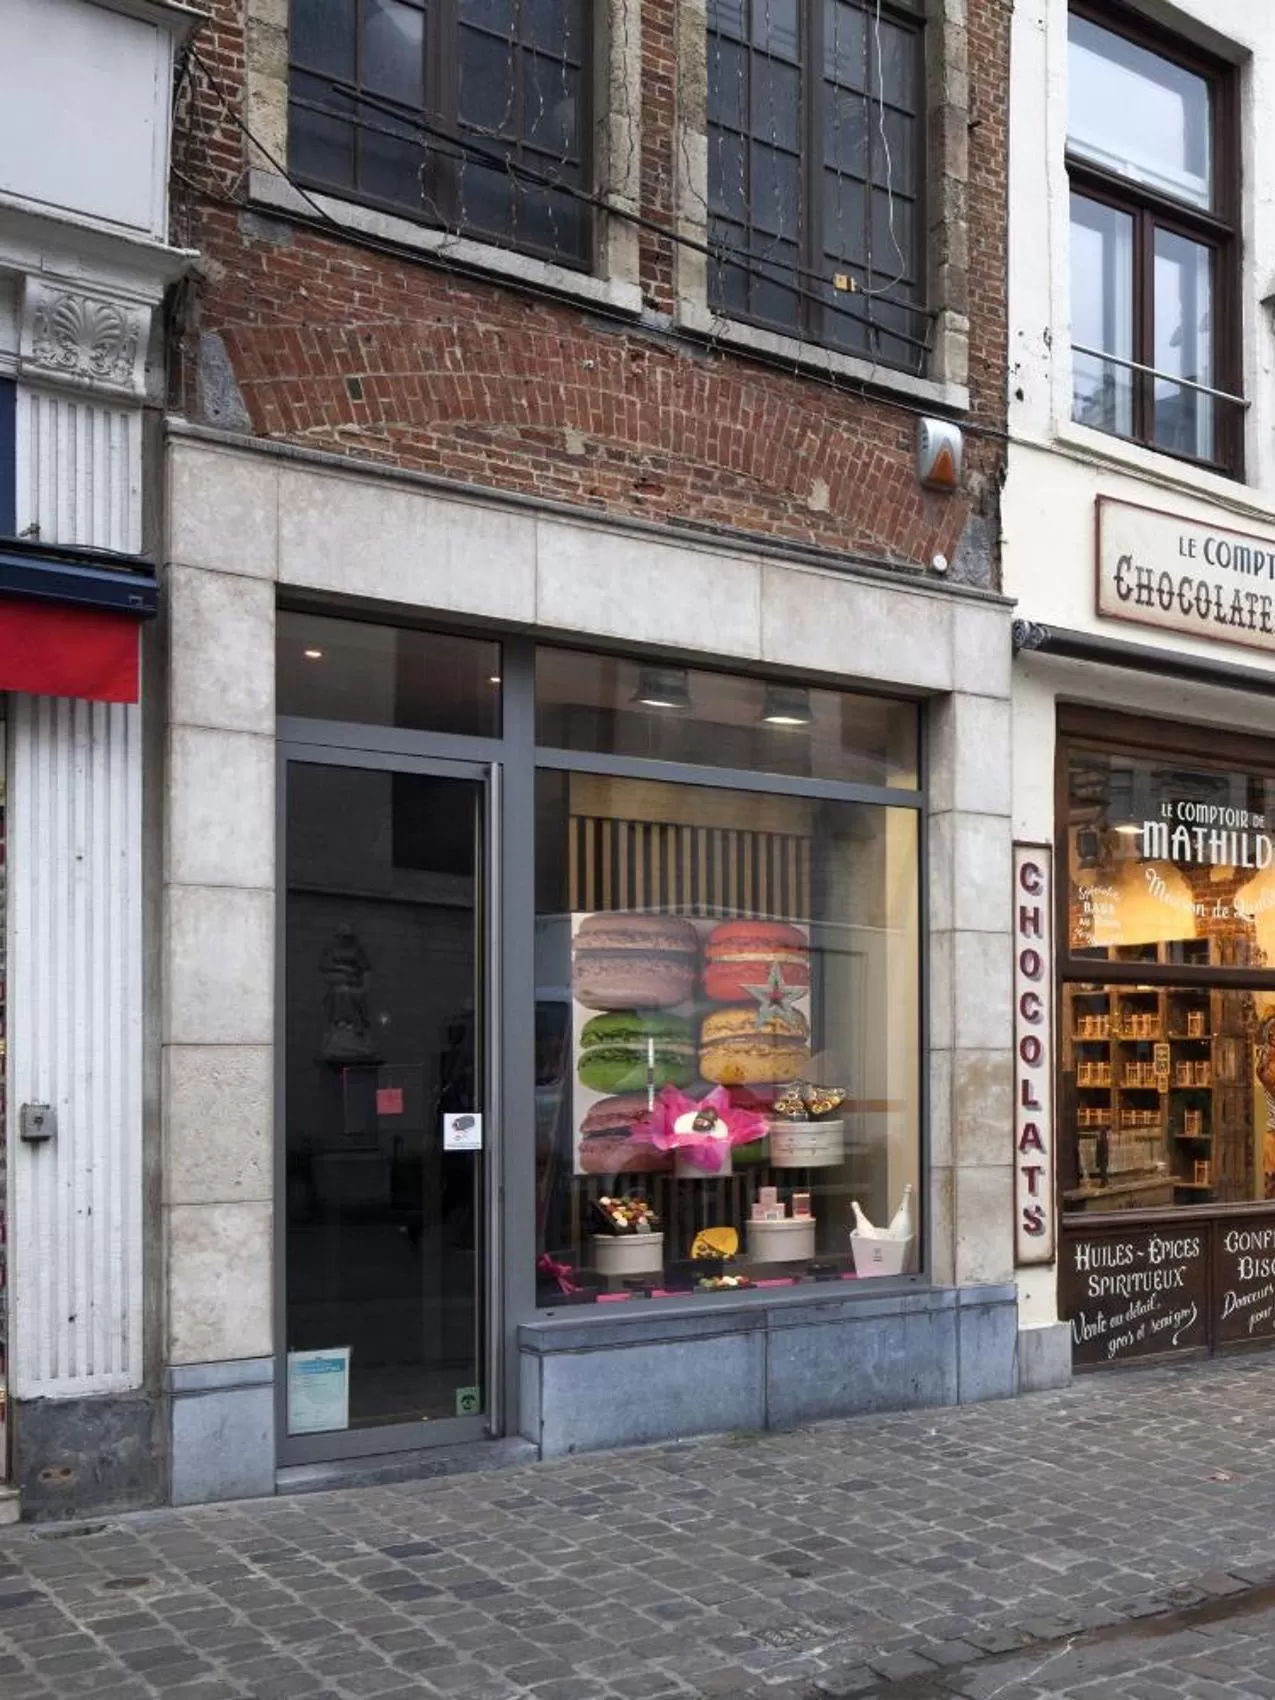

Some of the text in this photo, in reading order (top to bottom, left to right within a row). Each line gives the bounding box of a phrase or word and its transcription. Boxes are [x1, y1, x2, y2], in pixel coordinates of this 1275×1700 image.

[1179, 536, 1196, 558] LE
[1161, 801, 1265, 829] LE COMPTOIR DE
[1212, 898, 1230, 918] de
[1019, 861, 1046, 1237] CHOCOLATS
[1074, 1244, 1133, 1271] HUILES
[1148, 1233, 1199, 1263] ÉPICES
[1088, 1266, 1187, 1298] SPIRITUEUX
[1069, 1311, 1107, 1344] Vente
[1110, 1314, 1122, 1328] au
[1249, 1306, 1272, 1333] pour
[1108, 1331, 1134, 1359] gros
